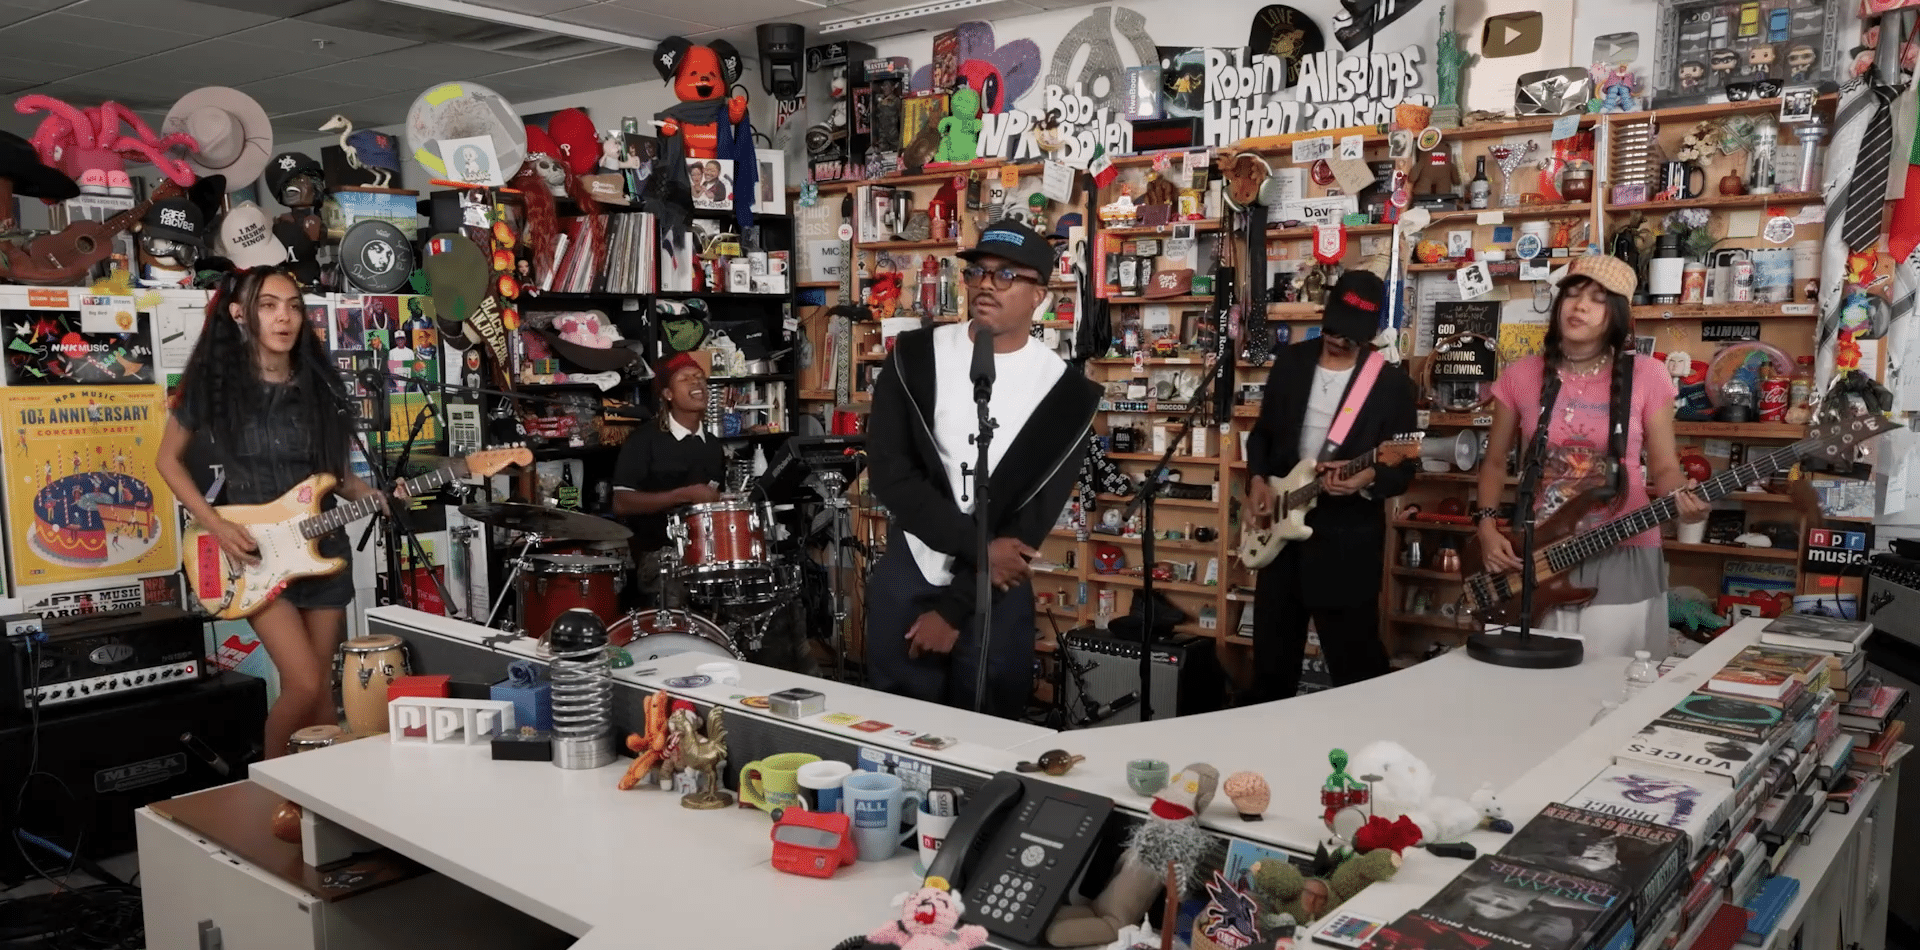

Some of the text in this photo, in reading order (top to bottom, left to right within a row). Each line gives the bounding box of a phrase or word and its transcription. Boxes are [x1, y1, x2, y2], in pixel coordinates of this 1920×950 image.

[1260, 7, 1293, 28] LOVE
[1204, 47, 1283, 102] Robin
[1296, 44, 1420, 109] Allsongs
[1047, 81, 1093, 124] Bob
[1128, 72, 1137, 114] HwaBoon
[778, 100, 795, 114] NO
[1204, 92, 1300, 148] Hilton
[976, 108, 1045, 159] NPR
[1056, 106, 1134, 170] Boilen
[232, 224, 267, 244] LAKSHMI
[244, 223, 258, 232] AM
[241, 233, 266, 248] SINGH
[1159, 280, 1178, 289] Trip
[83, 296, 111, 305] npr
[480, 296, 503, 337] BLACK
[1219, 308, 1227, 333] Nile
[1438, 324, 1455, 335] GOD
[51, 344, 109, 352] NHK MUSIC
[1436, 350, 1476, 362] GROWING
[1434, 364, 1484, 376] & GLOWING.
[55, 392, 76, 404] NPR
[82, 391, 116, 402] MUSIC
[20, 408, 45, 425] 10TH
[37, 428, 87, 436] CONCERT
[1813, 532, 1860, 547] npr
[1808, 549, 1864, 565] music
[100, 588, 141, 600] MUSIC
[111, 601, 141, 612] 2008
[398, 705, 497, 741] npr
[1627, 743, 1732, 770] VOICES
[105, 757, 181, 782] MESA
[856, 801, 886, 812] ALL
[1582, 799, 1660, 823] PRINCE
[1541, 805, 1677, 843] SPRINGSTEEN
[1490, 859, 1610, 896] BROTHER
[1503, 874, 1617, 908] DREAM
[1420, 913, 1532, 949] RADHIKA PHILIP
